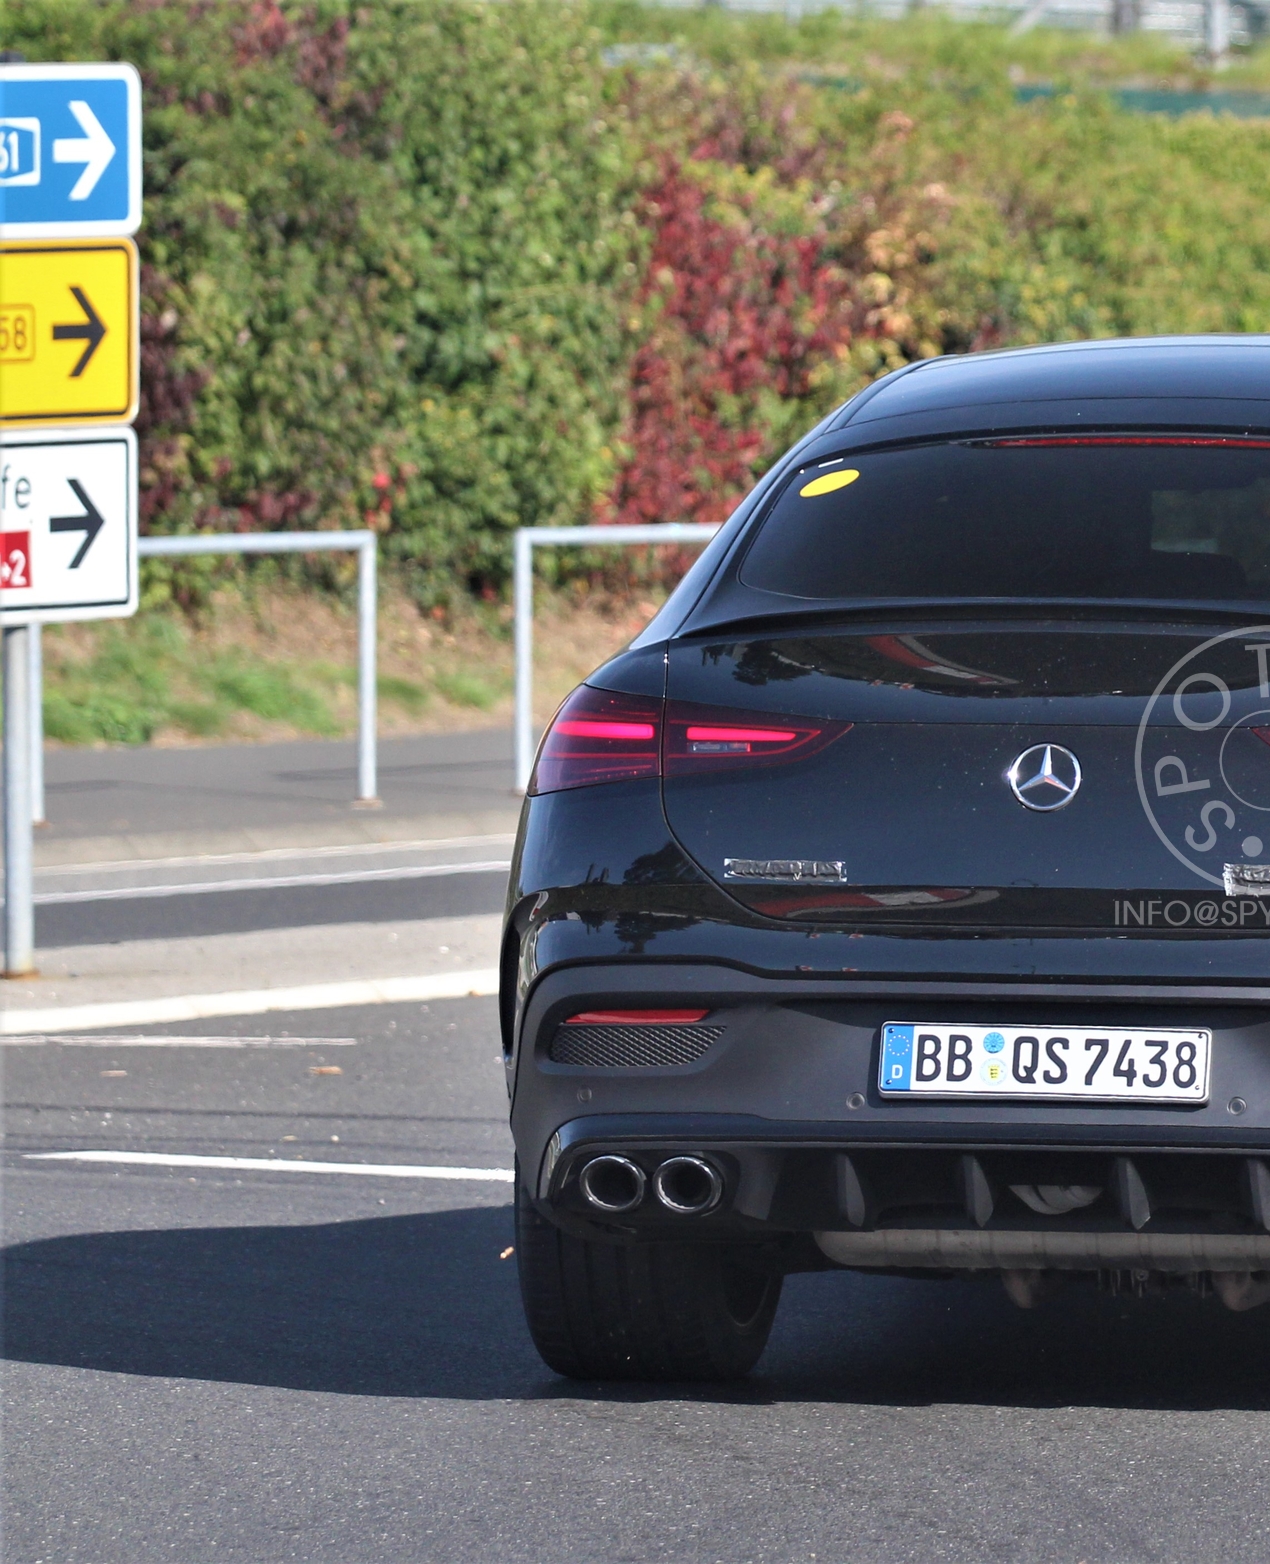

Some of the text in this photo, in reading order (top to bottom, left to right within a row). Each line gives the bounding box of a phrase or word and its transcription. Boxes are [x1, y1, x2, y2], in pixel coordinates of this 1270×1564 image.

[891, 1064, 903, 1079] D
[915, 1034, 1197, 1088] BB QS 7438
